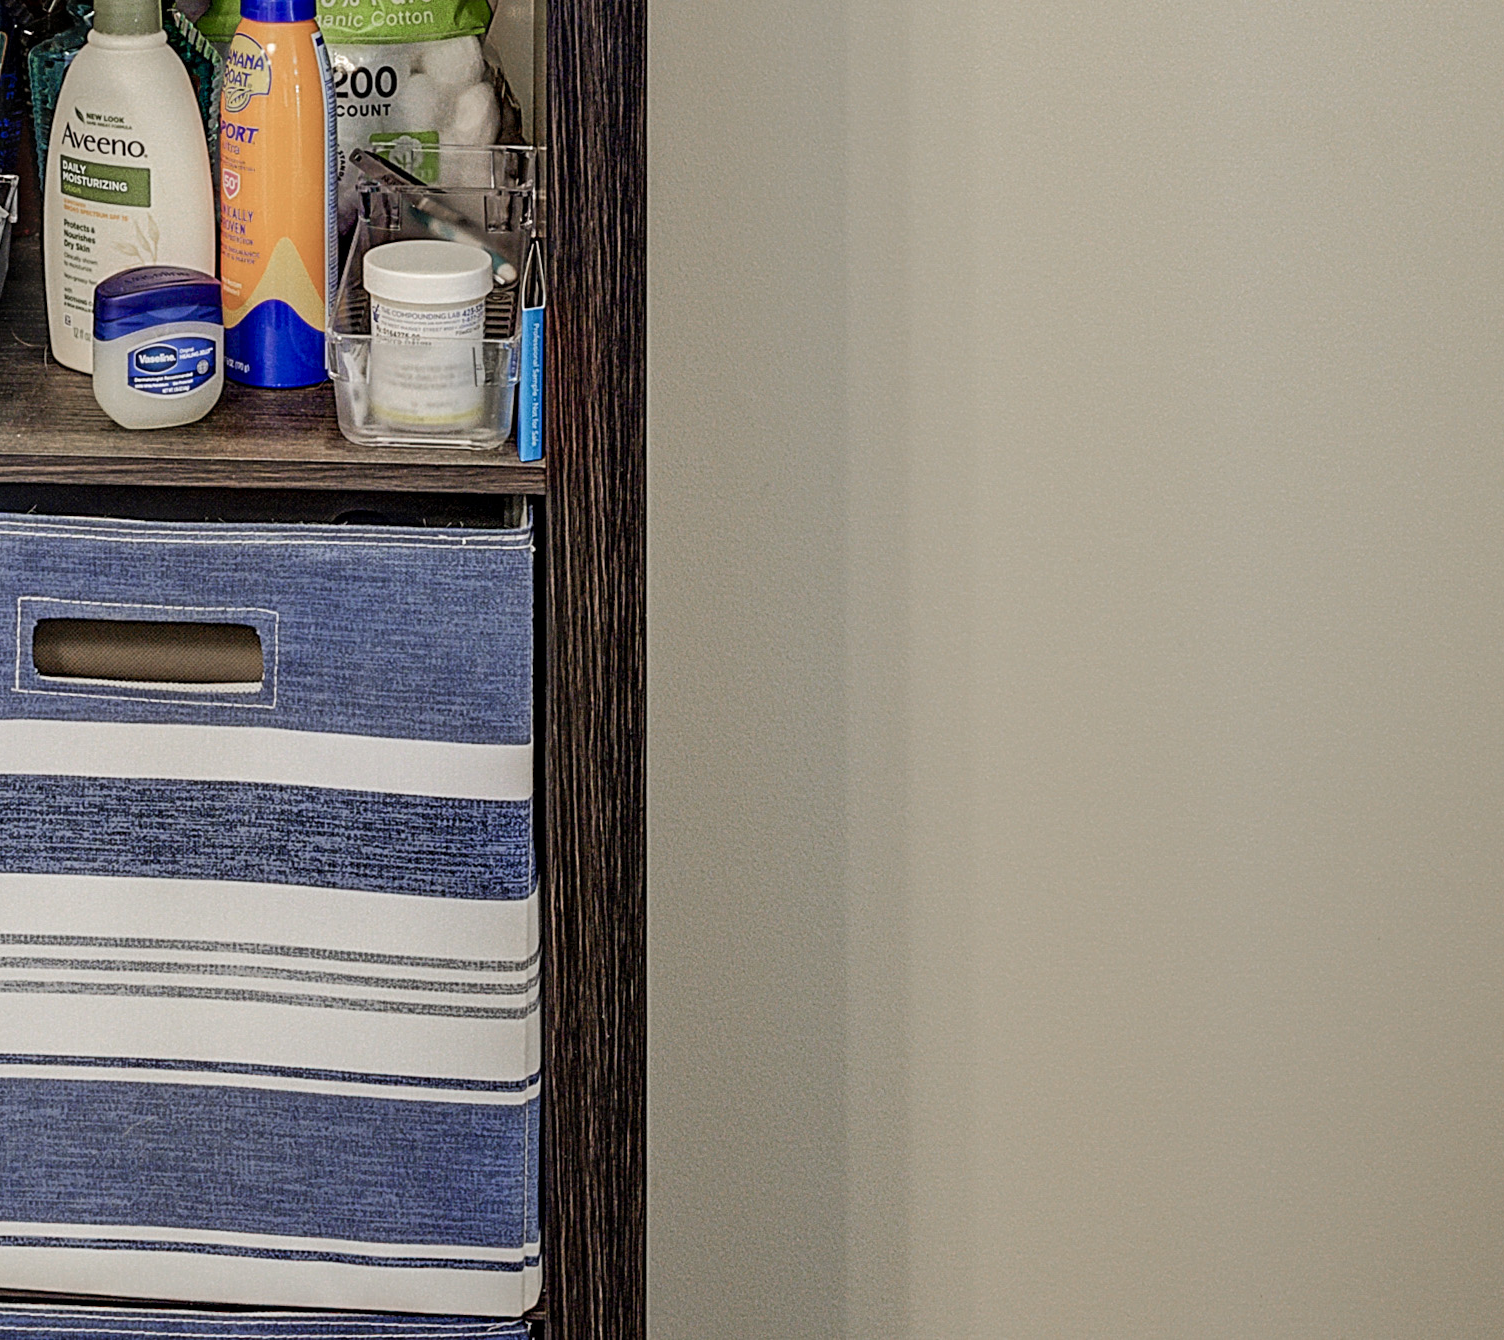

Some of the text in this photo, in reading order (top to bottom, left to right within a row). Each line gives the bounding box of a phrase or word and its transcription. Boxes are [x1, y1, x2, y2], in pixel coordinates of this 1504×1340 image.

[371, 10, 434, 28] Cotton
[334, 66, 398, 99] 200
[86, 112, 126, 124] NEW LOOK
[336, 103, 392, 118] COUNT
[62, 121, 145, 158] Aveeno
[62, 160, 87, 174] DAILY
[62, 172, 128, 192] MOISTURIZING
[64, 218, 90, 233] Protects
[64, 229, 96, 245] Nourishes
[64, 239, 90, 253] Dry Skin
[392, 310, 446, 320] COMPOUNDING
[531, 368, 540, 397] Sample
[532, 430, 540, 446] Sale
